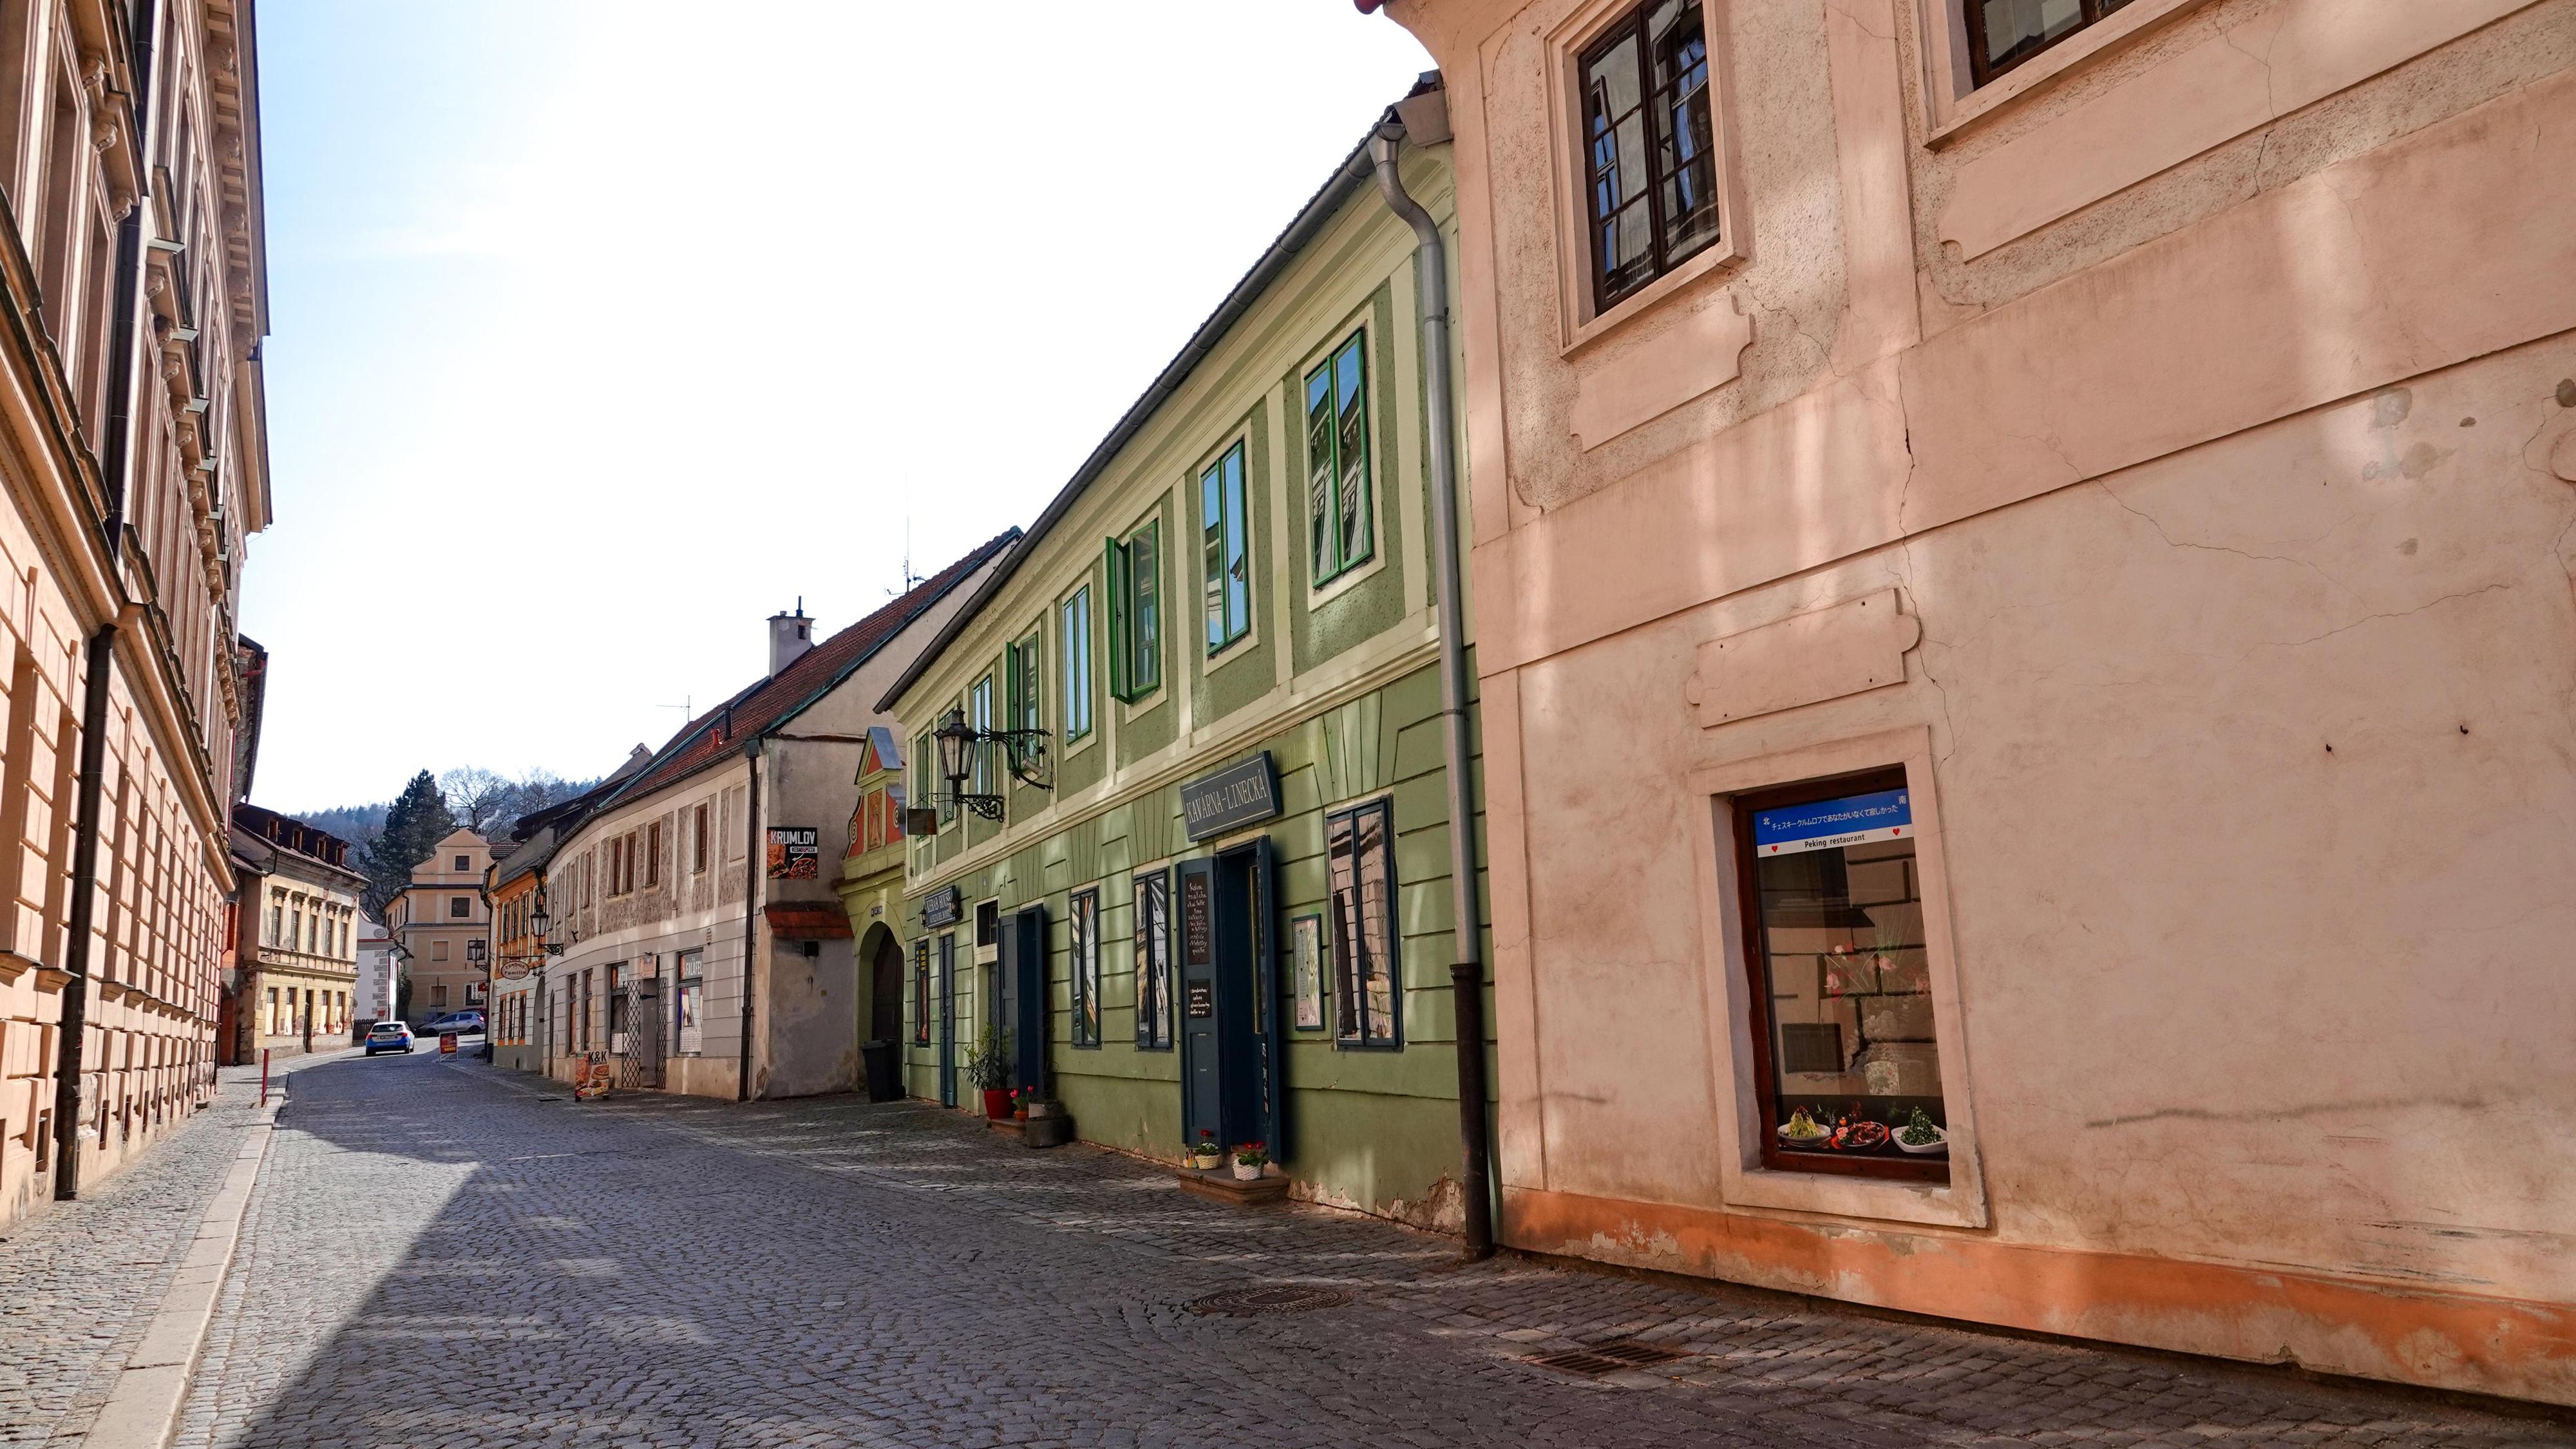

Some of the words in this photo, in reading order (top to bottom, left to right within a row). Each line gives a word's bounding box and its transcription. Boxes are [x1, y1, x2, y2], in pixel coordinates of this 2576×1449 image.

[1898, 795, 1906, 804] 南
[1763, 817, 1770, 826] 北
[770, 831, 815, 844] KRUMLOV
[1804, 838, 1827, 848] Peking
[1830, 834, 1865, 845] restaurant
[686, 960, 703, 976] FALAFEL
[589, 1050, 607, 1063] K&K
